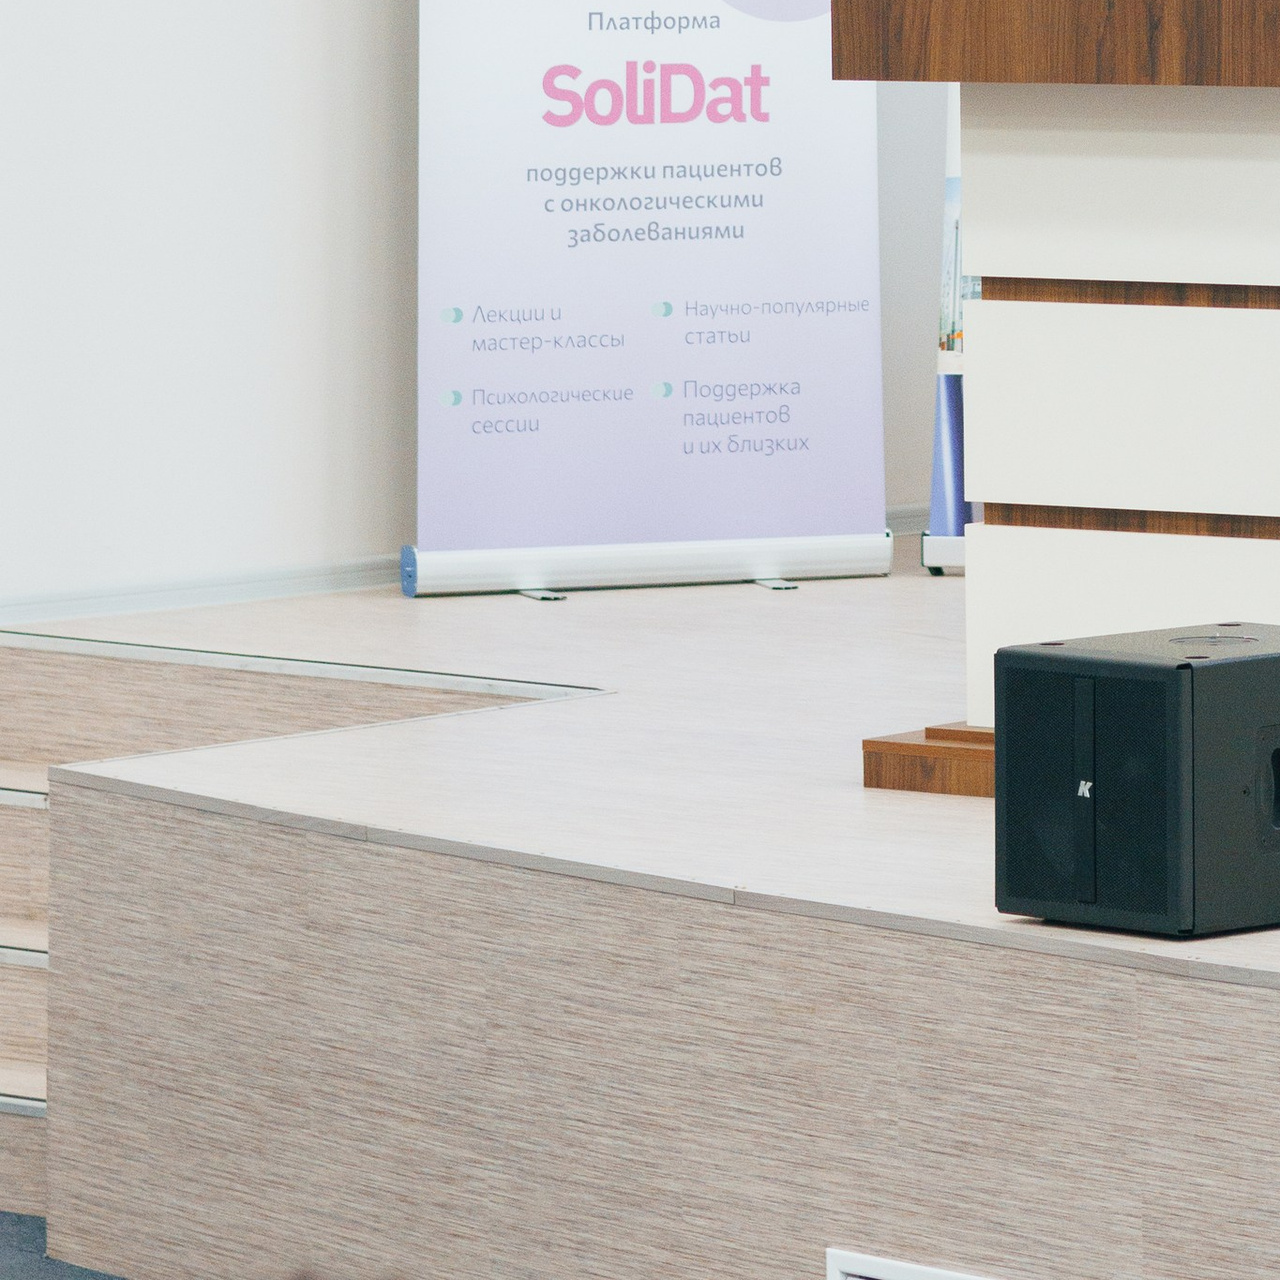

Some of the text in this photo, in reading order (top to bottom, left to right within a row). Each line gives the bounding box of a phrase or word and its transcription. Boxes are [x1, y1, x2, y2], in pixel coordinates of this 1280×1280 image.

[587, 9, 721, 36] Платформа
[541, 59, 771, 128] SoliDat
[526, 156, 783, 187] поддержки пациентов
[543, 193, 764, 214] с онкологическими
[567, 220, 745, 249] заболеваниями
[471, 304, 562, 325] Лекции и
[684, 298, 871, 320] Научно-популярные
[471, 333, 625, 355] мастер-классы
[683, 329, 751, 346] статьи
[471, 387, 635, 406] Психологические
[682, 379, 802, 403] Поддержка
[470, 418, 540, 435] сессии
[682, 403, 791, 429] пациентов
[682, 433, 810, 458] и их близких
[1077, 780, 1093, 798] K
